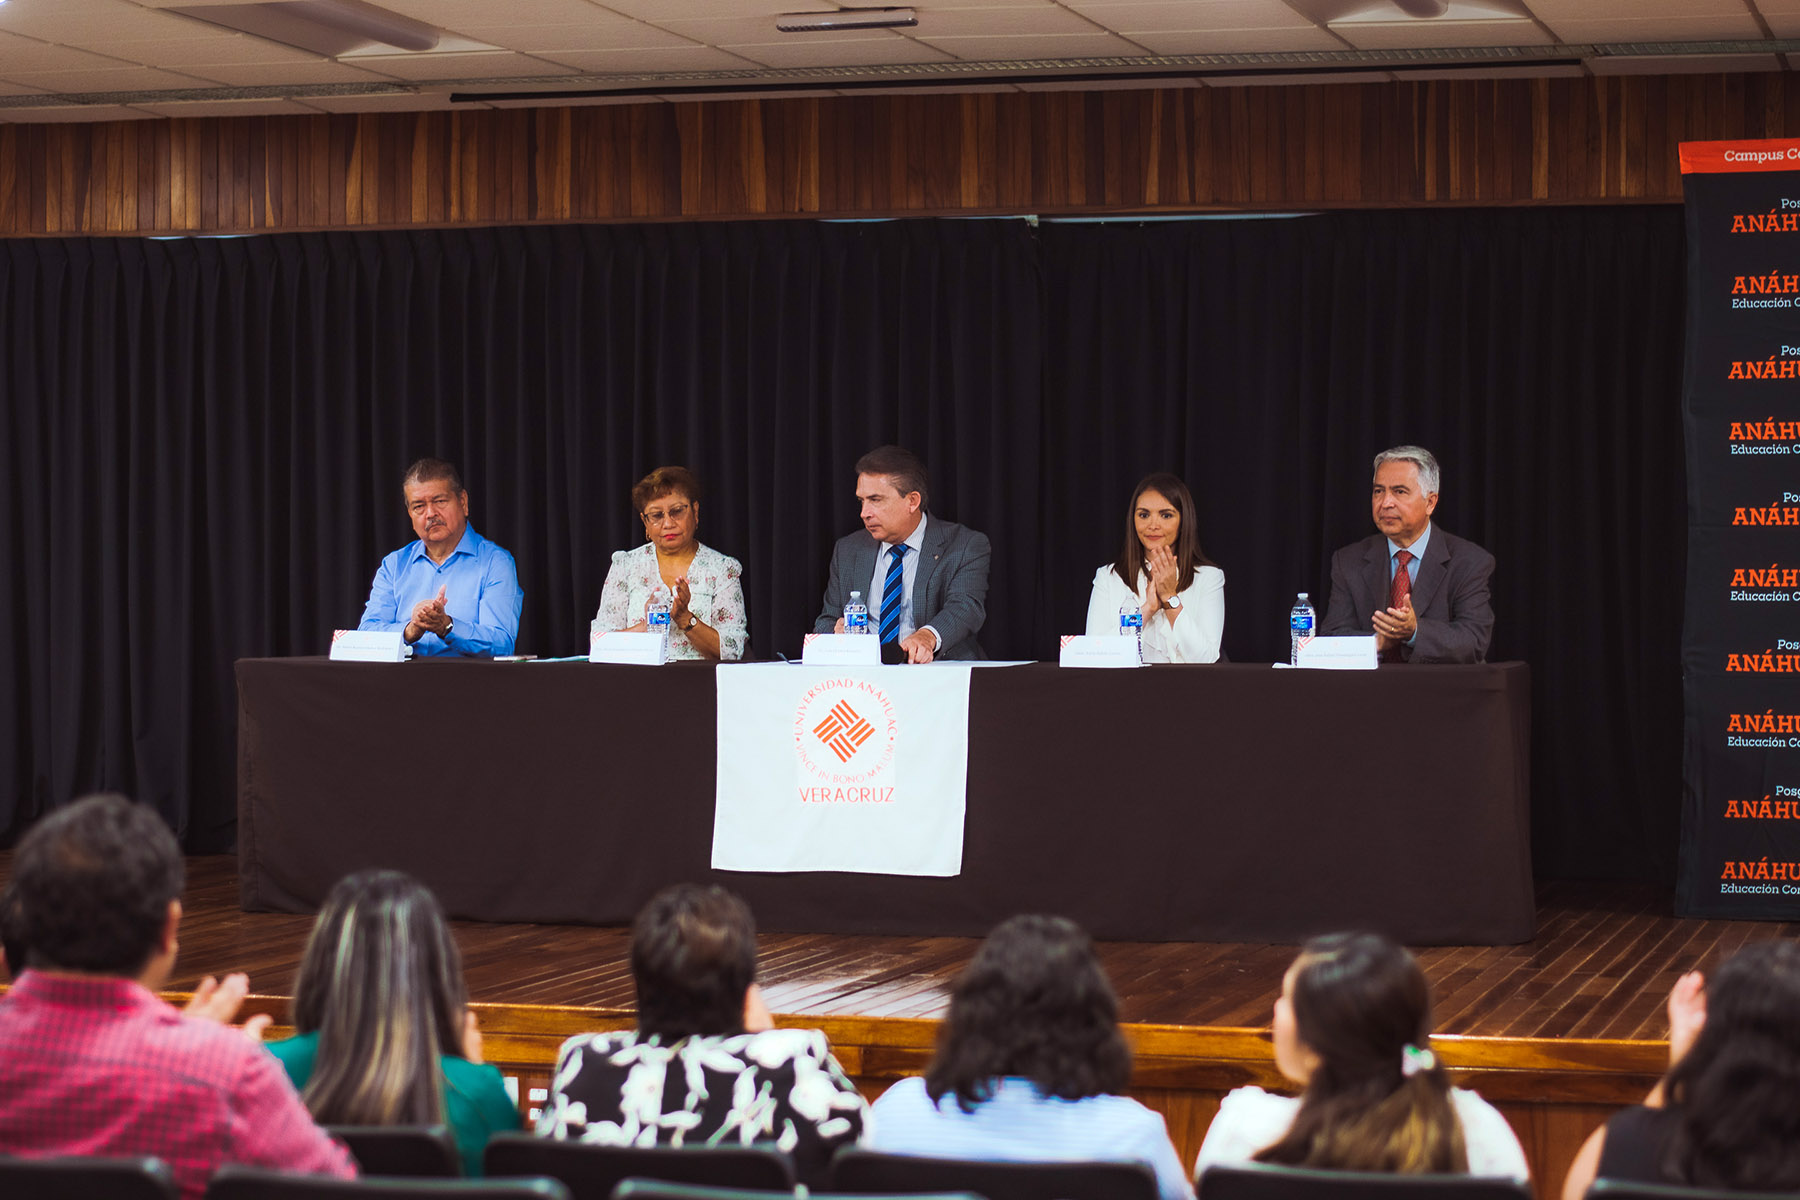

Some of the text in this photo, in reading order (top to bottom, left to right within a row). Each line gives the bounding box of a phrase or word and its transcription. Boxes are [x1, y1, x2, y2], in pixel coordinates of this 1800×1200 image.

[1723, 150, 1784, 164] Campus
[1730, 208, 1800, 233] ANÁH
[1731, 297, 1792, 309] Educación
[1727, 355, 1800, 380] ANÁH
[1728, 416, 1800, 441] ANÁH
[1730, 443, 1791, 455] Educación
[1783, 492, 1800, 503] Po
[1730, 563, 1800, 588] ANÁH
[1730, 590, 1790, 602] Educación
[1776, 639, 1800, 650] Pos
[794, 678, 898, 736] UNIVERSIDAD ANÁHUAC
[1727, 736, 1787, 748] Educación
[796, 744, 817, 774] VINCE
[817, 769, 830, 781] IN
[832, 774, 865, 785] BONO
[799, 786, 895, 803] VERACRUZ
[1720, 882, 1780, 895] Educación
